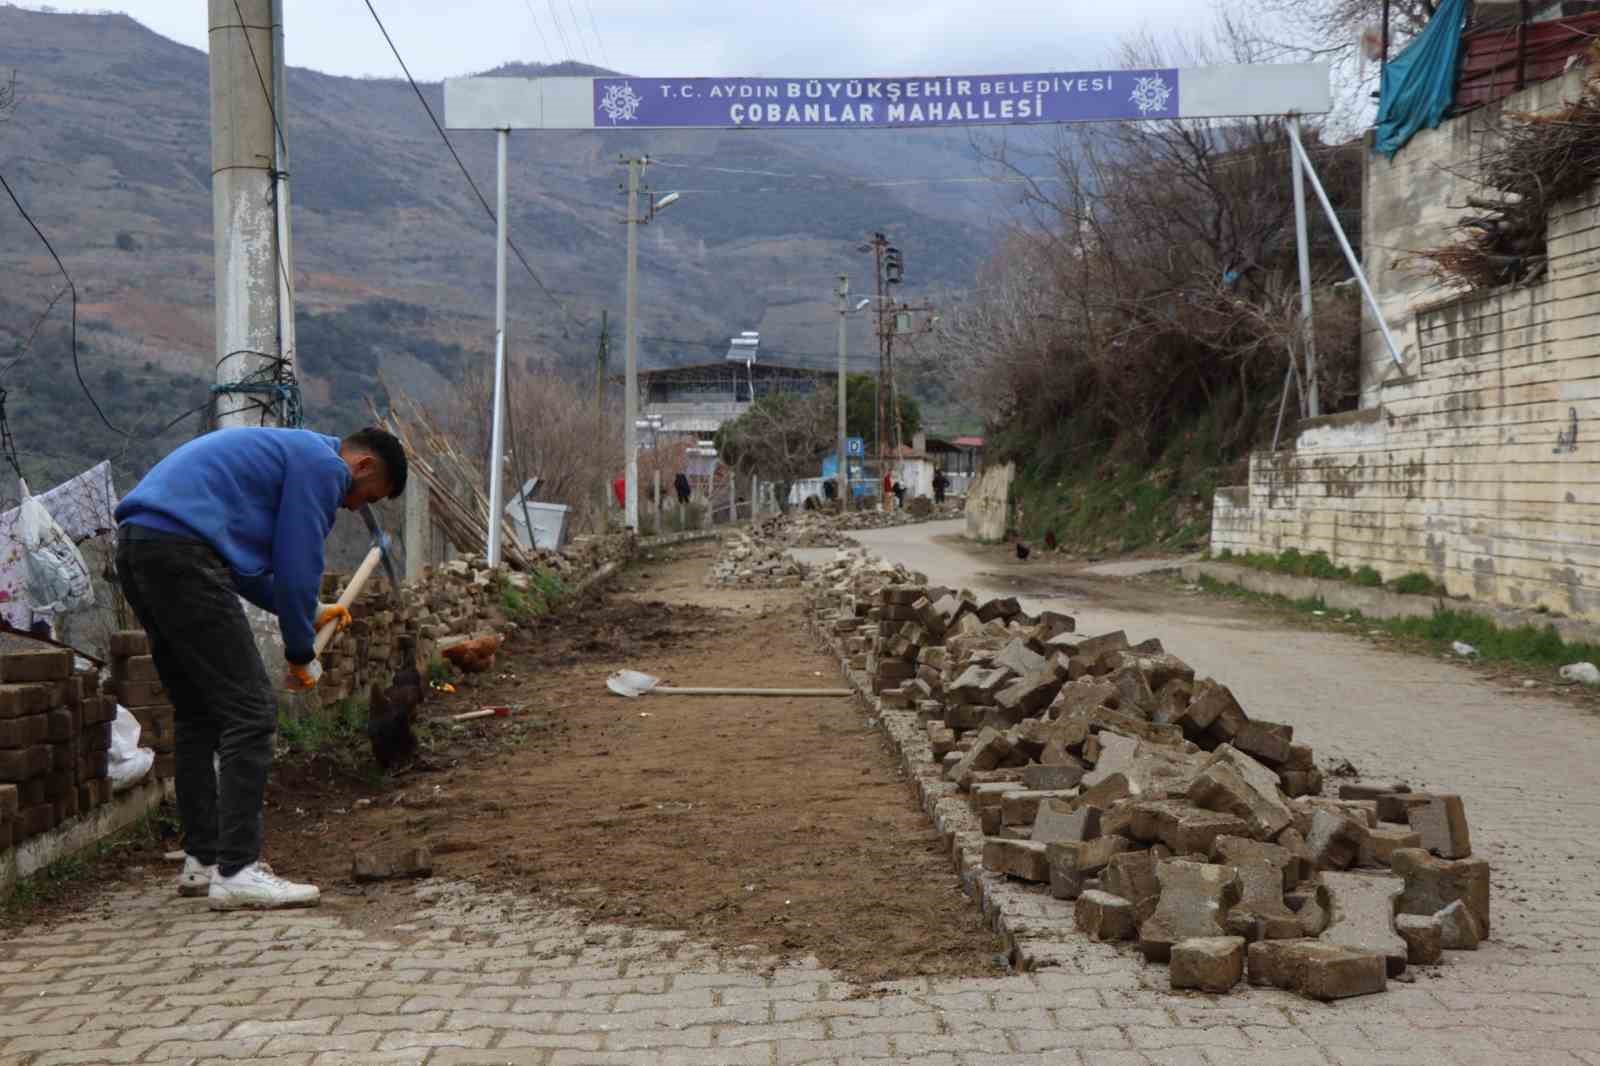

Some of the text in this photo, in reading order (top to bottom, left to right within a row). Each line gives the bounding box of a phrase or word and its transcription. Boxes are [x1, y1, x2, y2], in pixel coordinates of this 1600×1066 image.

[661, 76, 1112, 101] T.C. AYDIN BÜYÜKŞEHİR BELEDİYESİ
[731, 95, 1042, 124] ÇOBANLAR MAHALLESİ
